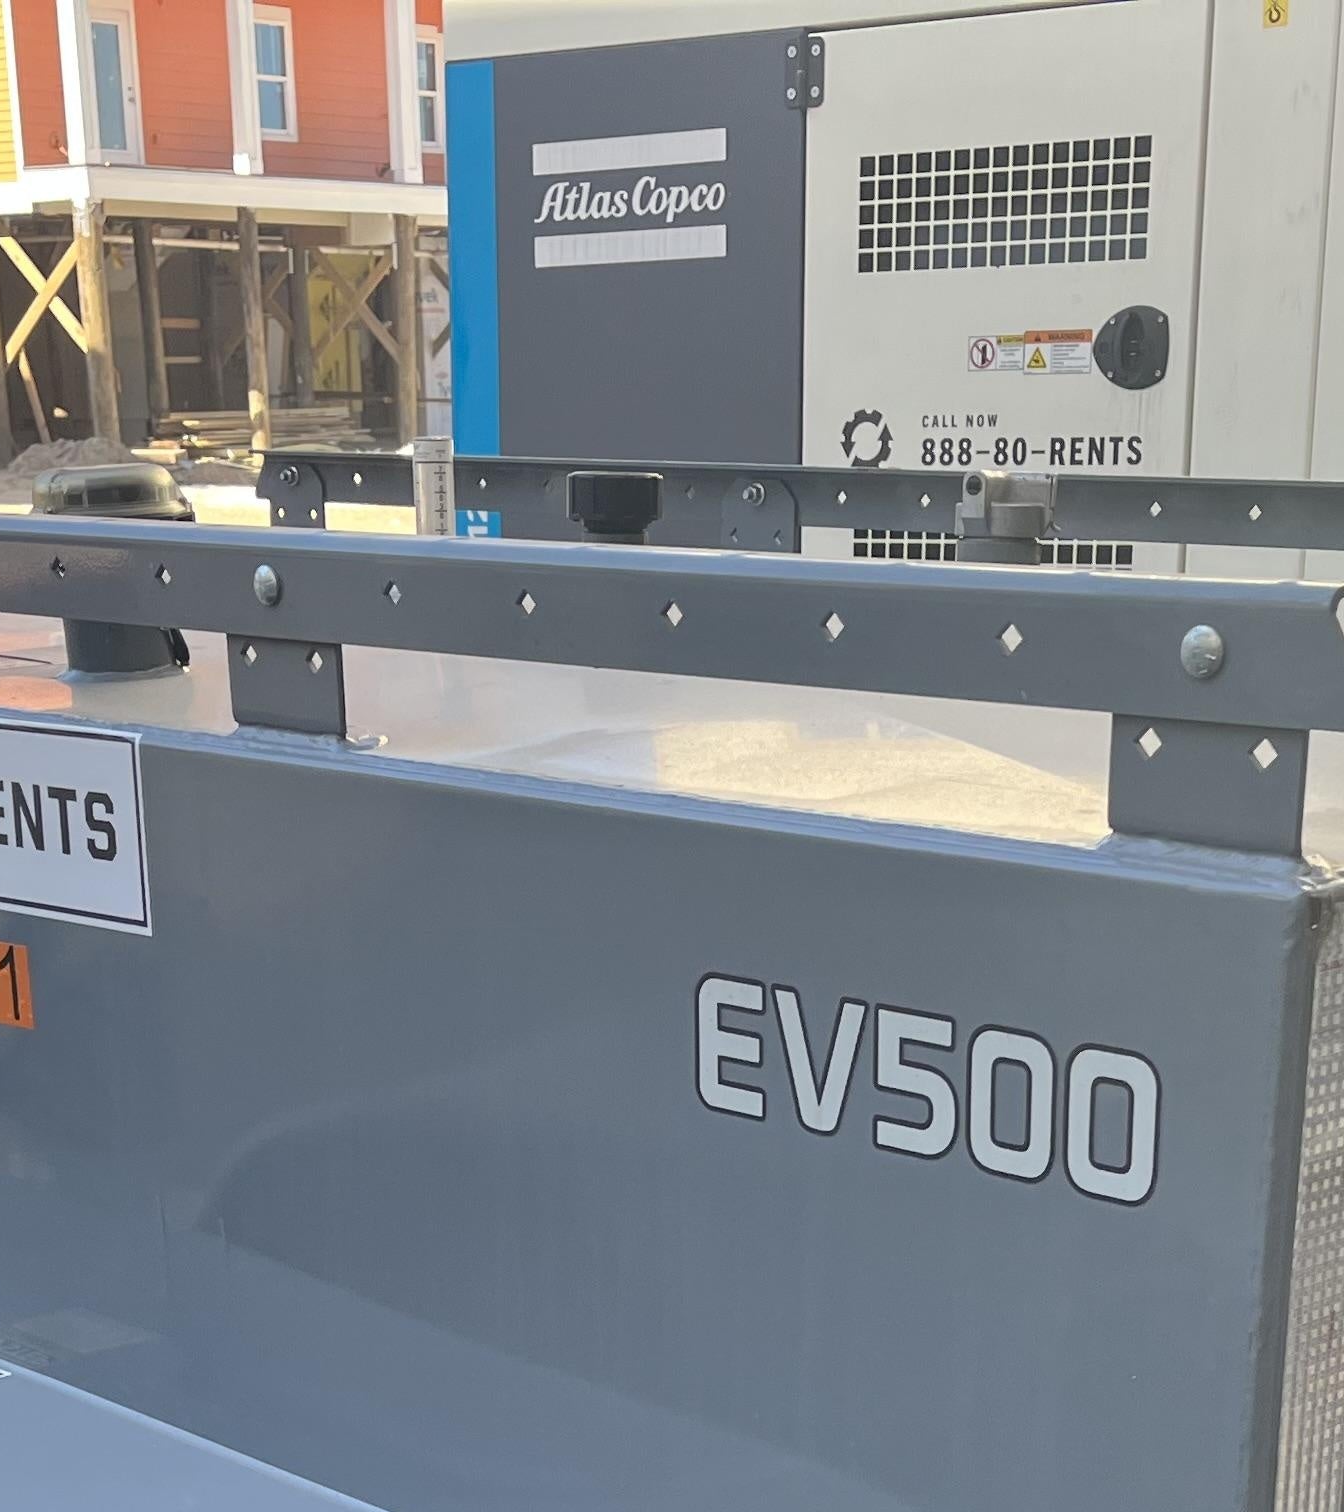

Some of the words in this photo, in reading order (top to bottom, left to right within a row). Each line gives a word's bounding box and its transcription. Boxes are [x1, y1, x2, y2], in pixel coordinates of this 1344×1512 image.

[533, 181, 629, 224] Atlas
[631, 175, 726, 223] Copco
[921, 415, 957, 428] CALL
[965, 414, 999, 428] NOW
[921, 436, 1143, 466] 888-80-RENTS
[694, 971, 1162, 1208] EV500
